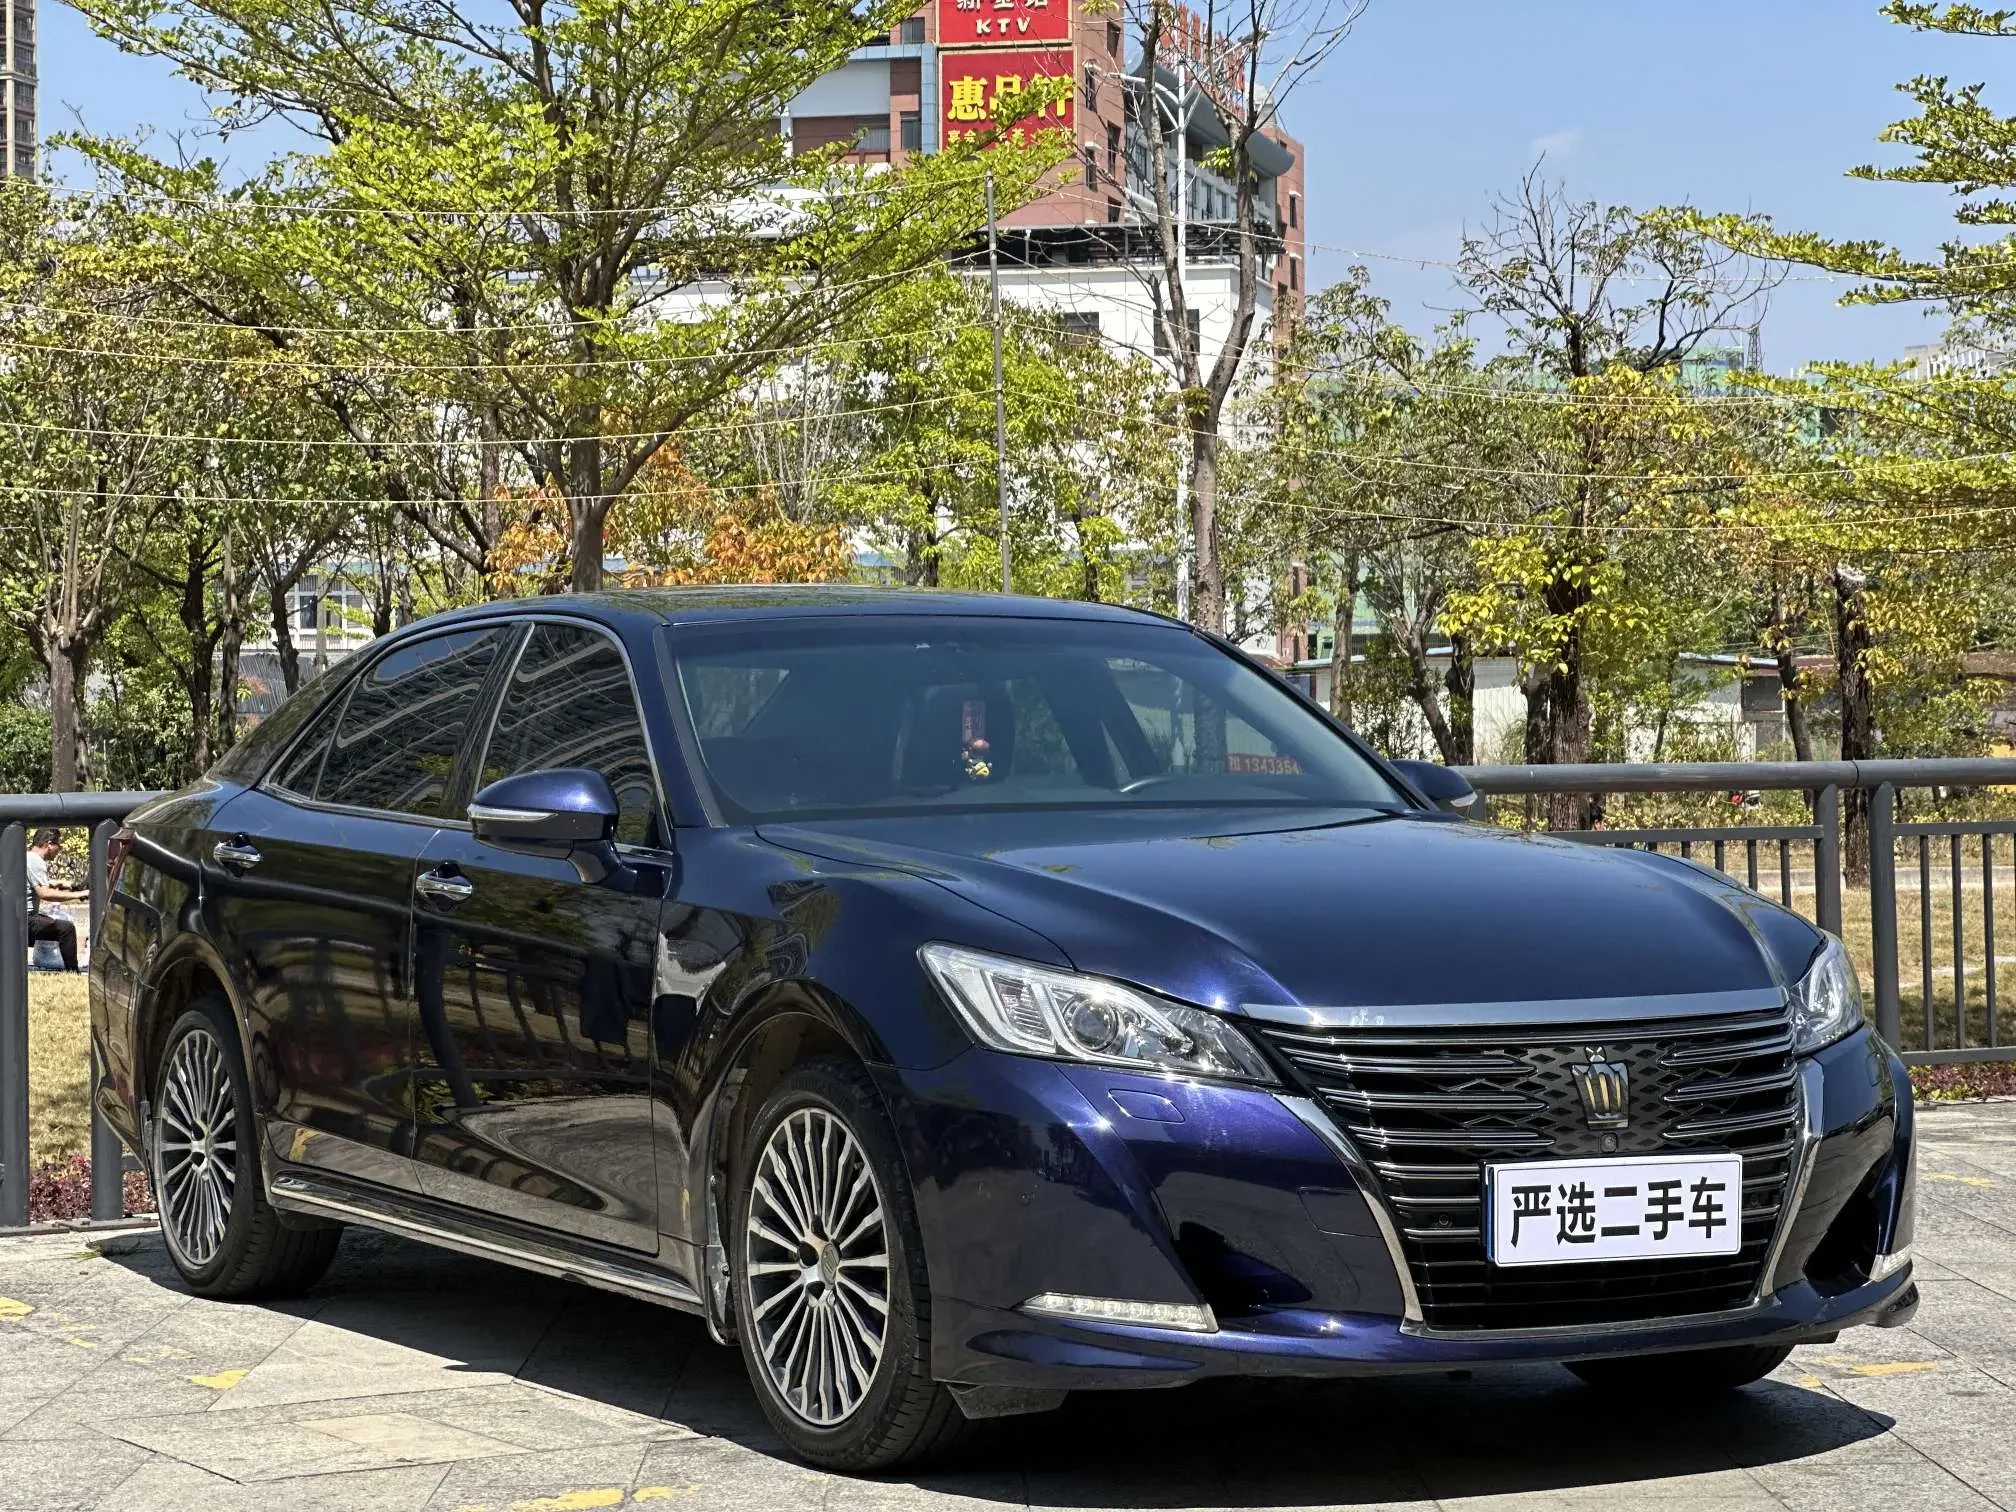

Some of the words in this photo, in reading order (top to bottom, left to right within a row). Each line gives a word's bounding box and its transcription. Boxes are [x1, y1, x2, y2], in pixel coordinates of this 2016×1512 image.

[975, 16, 1031, 34] KTV
[1510, 1176, 1728, 1248] 严选二手车
